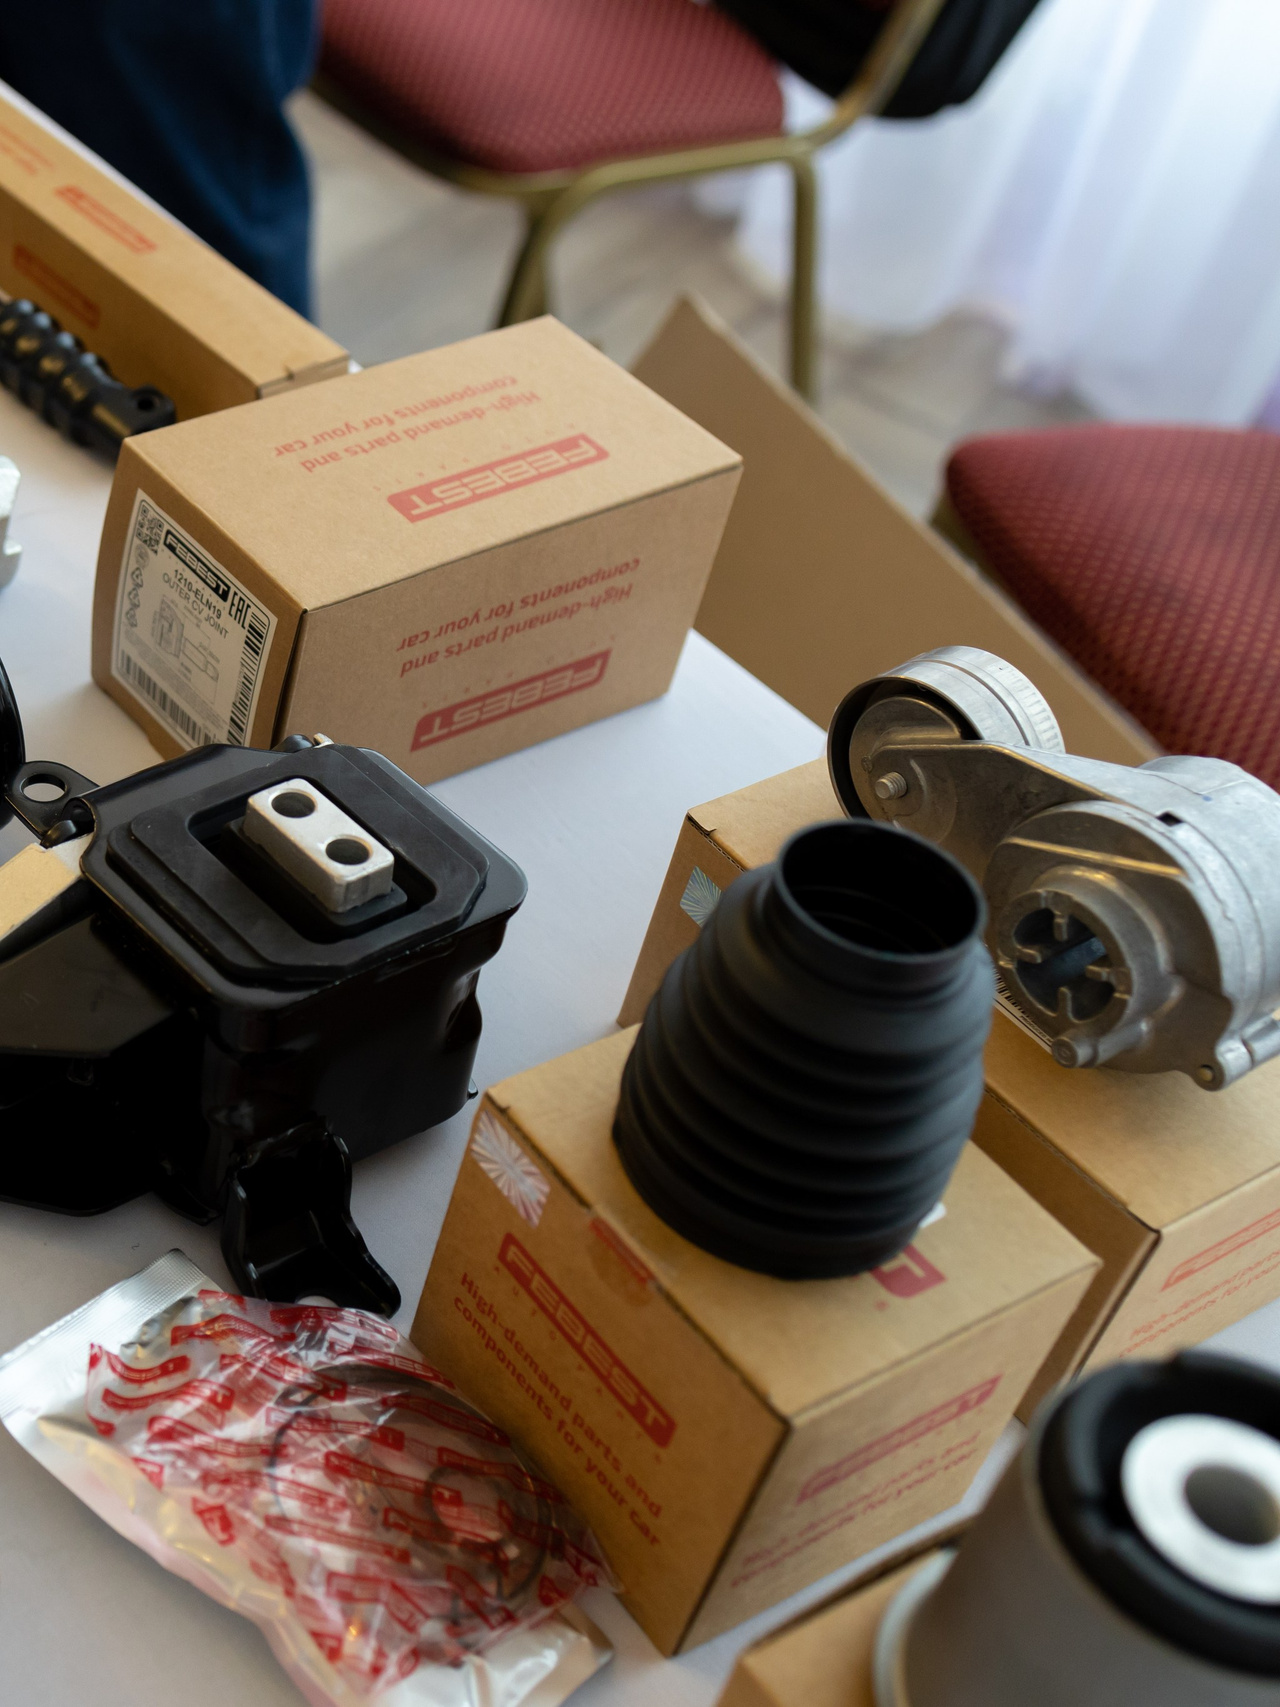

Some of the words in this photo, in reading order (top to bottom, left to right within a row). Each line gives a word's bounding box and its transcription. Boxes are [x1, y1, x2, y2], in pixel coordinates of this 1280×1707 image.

[395, 374, 518, 420] components
[404, 390, 542, 441] High-demand
[312, 421, 359, 448] your
[344, 430, 401, 458] parts
[363, 413, 395, 433] for
[274, 439, 307, 457] car
[301, 452, 342, 473] and
[407, 438, 600, 516] FEBEST
[165, 531, 230, 598] FEBEST
[520, 558, 640, 604] components
[162, 573, 191, 604] OUTER
[191, 600, 204, 615] CV
[205, 614, 229, 639] JOINT
[174, 569, 222, 620] 1210-ELN19
[485, 601, 514, 620] for
[501, 583, 633, 643] High-demand
[396, 630, 430, 652] car
[434, 608, 482, 639] your
[444, 625, 499, 652] parts
[400, 654, 440, 678] and
[418, 656, 604, 744] FEBEST
[505, 1242, 670, 1428] FEBEST
[460, 1271, 573, 1413] High-demand
[572, 1412, 622, 1472] parts
[625, 1474, 662, 1518] and
[454, 1296, 552, 1421] components
[556, 1418, 583, 1454] for
[586, 1456, 627, 1506] your
[629, 1510, 661, 1546] car
